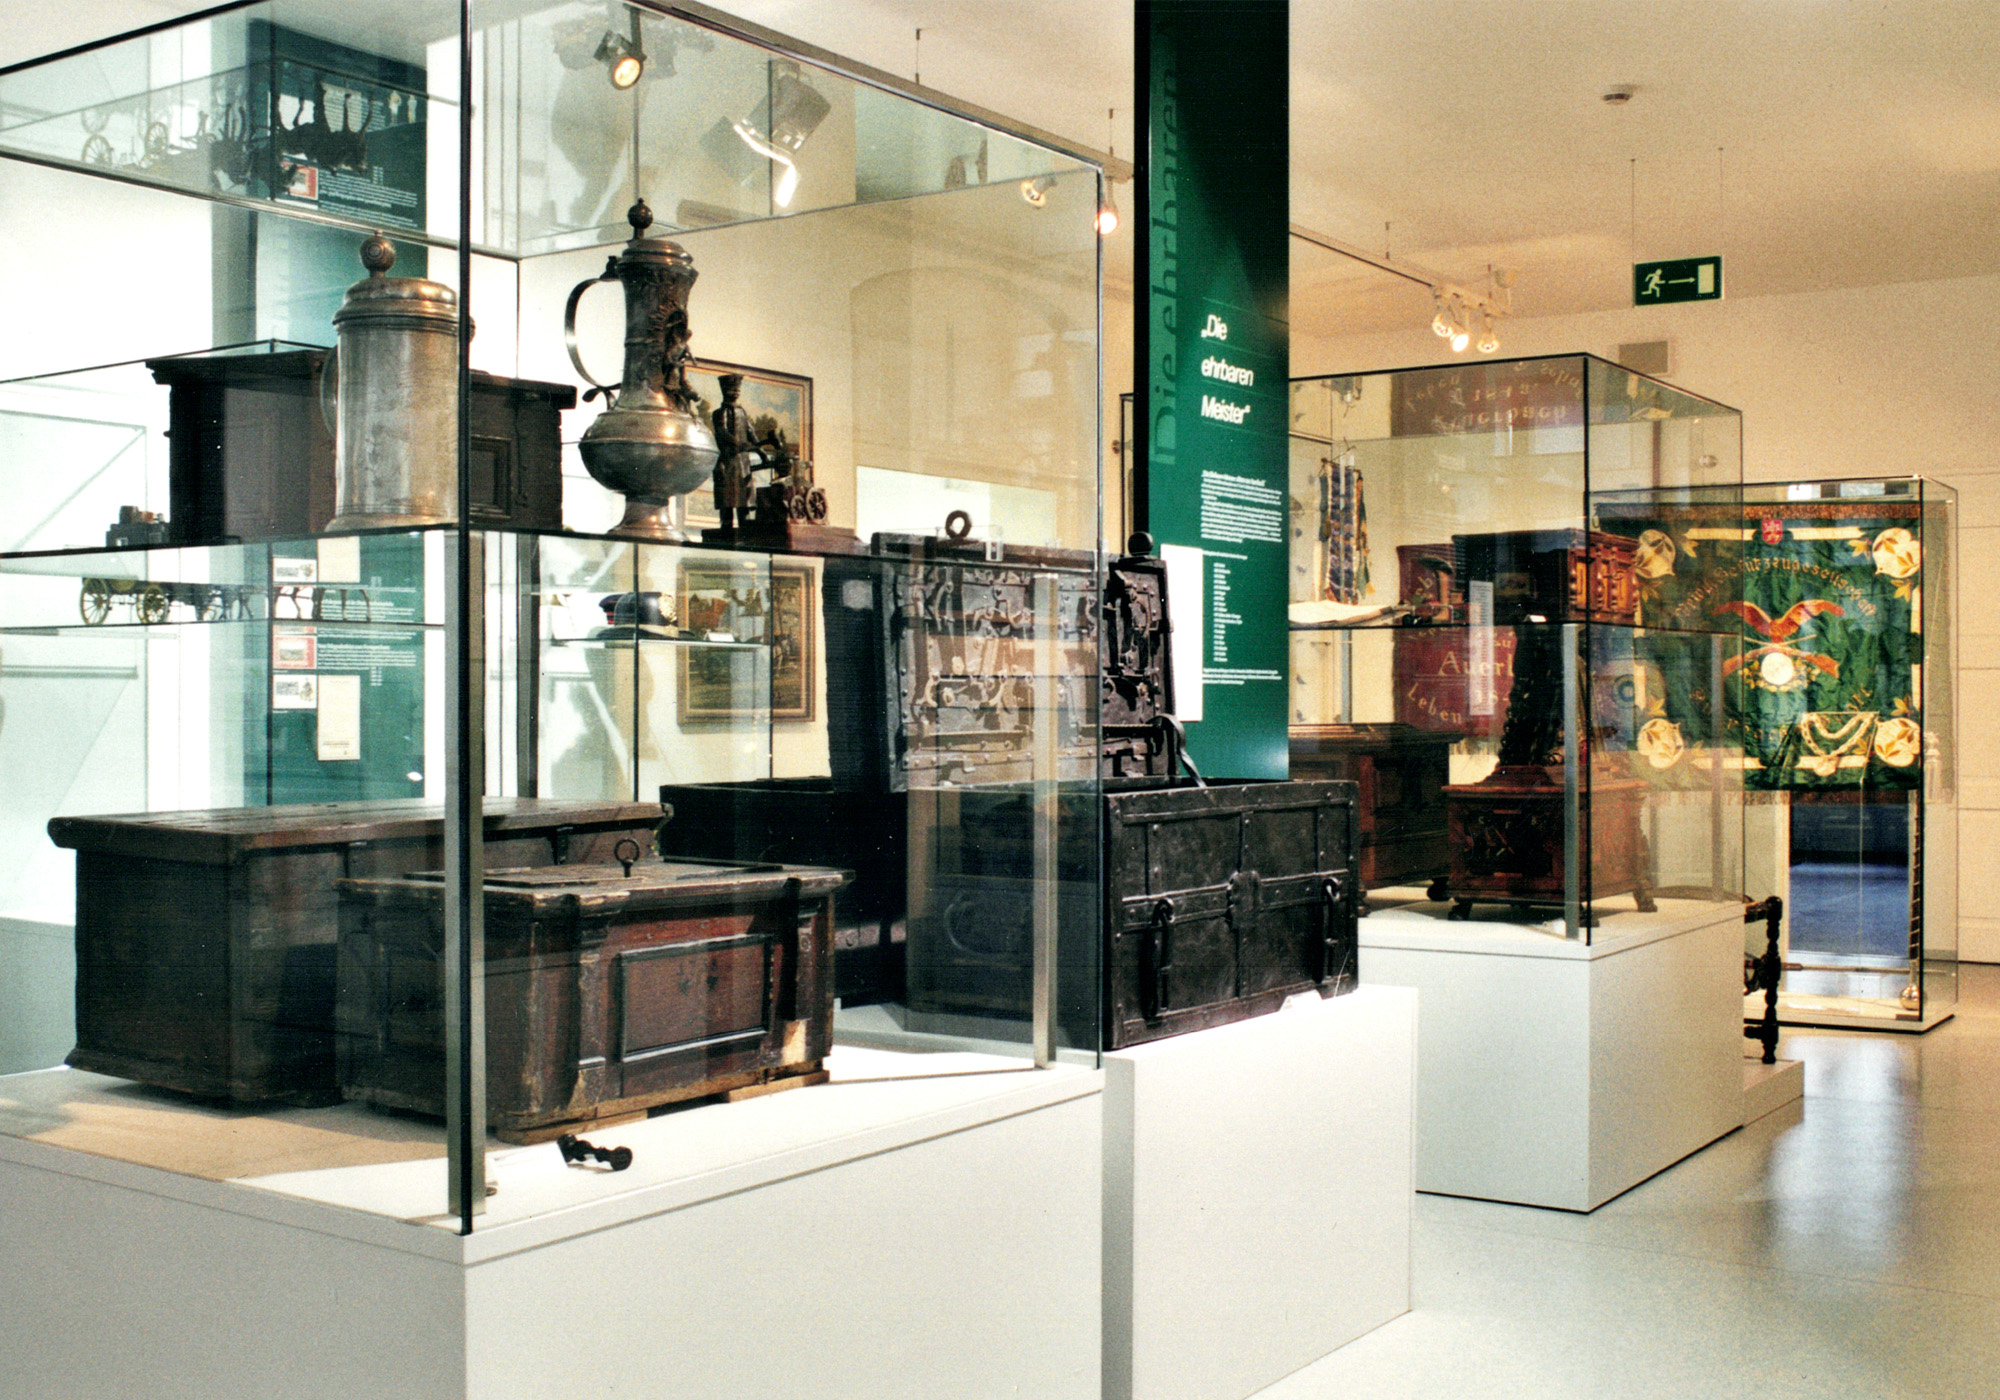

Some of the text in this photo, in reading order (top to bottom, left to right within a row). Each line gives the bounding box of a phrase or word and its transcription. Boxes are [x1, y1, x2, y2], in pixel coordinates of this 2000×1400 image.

[1201, 356, 1254, 387] ehrbaren
[1154, 354, 1178, 456] Die
[1407, 682, 1463, 725] Leben
